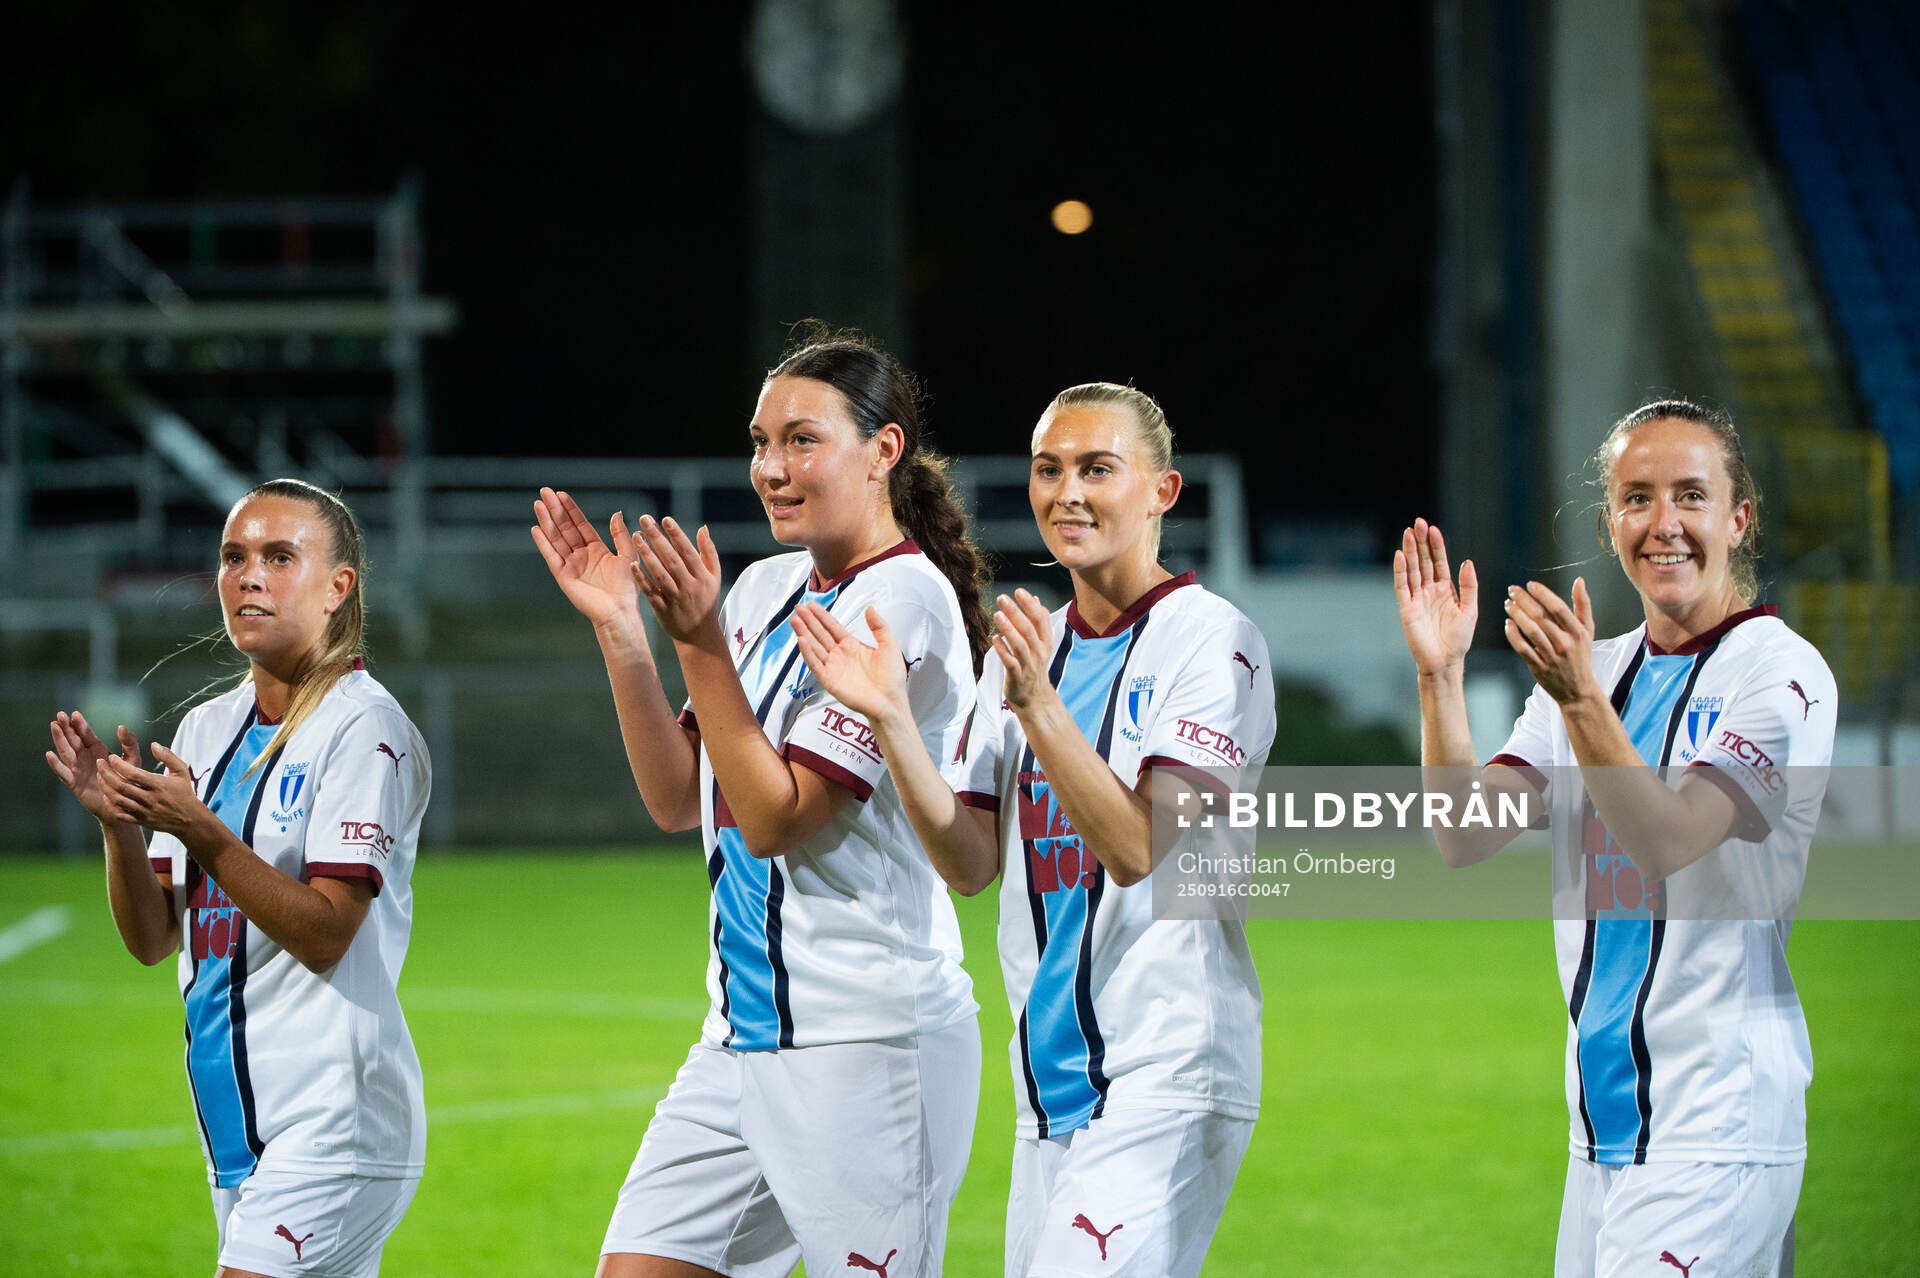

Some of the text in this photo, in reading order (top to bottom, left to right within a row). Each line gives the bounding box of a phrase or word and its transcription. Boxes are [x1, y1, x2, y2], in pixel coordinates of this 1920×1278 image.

[821, 706, 884, 758] TICTA
[829, 741, 864, 764] LEARN
[1176, 719, 1246, 767] TICTAC
[1719, 730, 1784, 791] TICTAC
[341, 821, 395, 854] TICTAC
